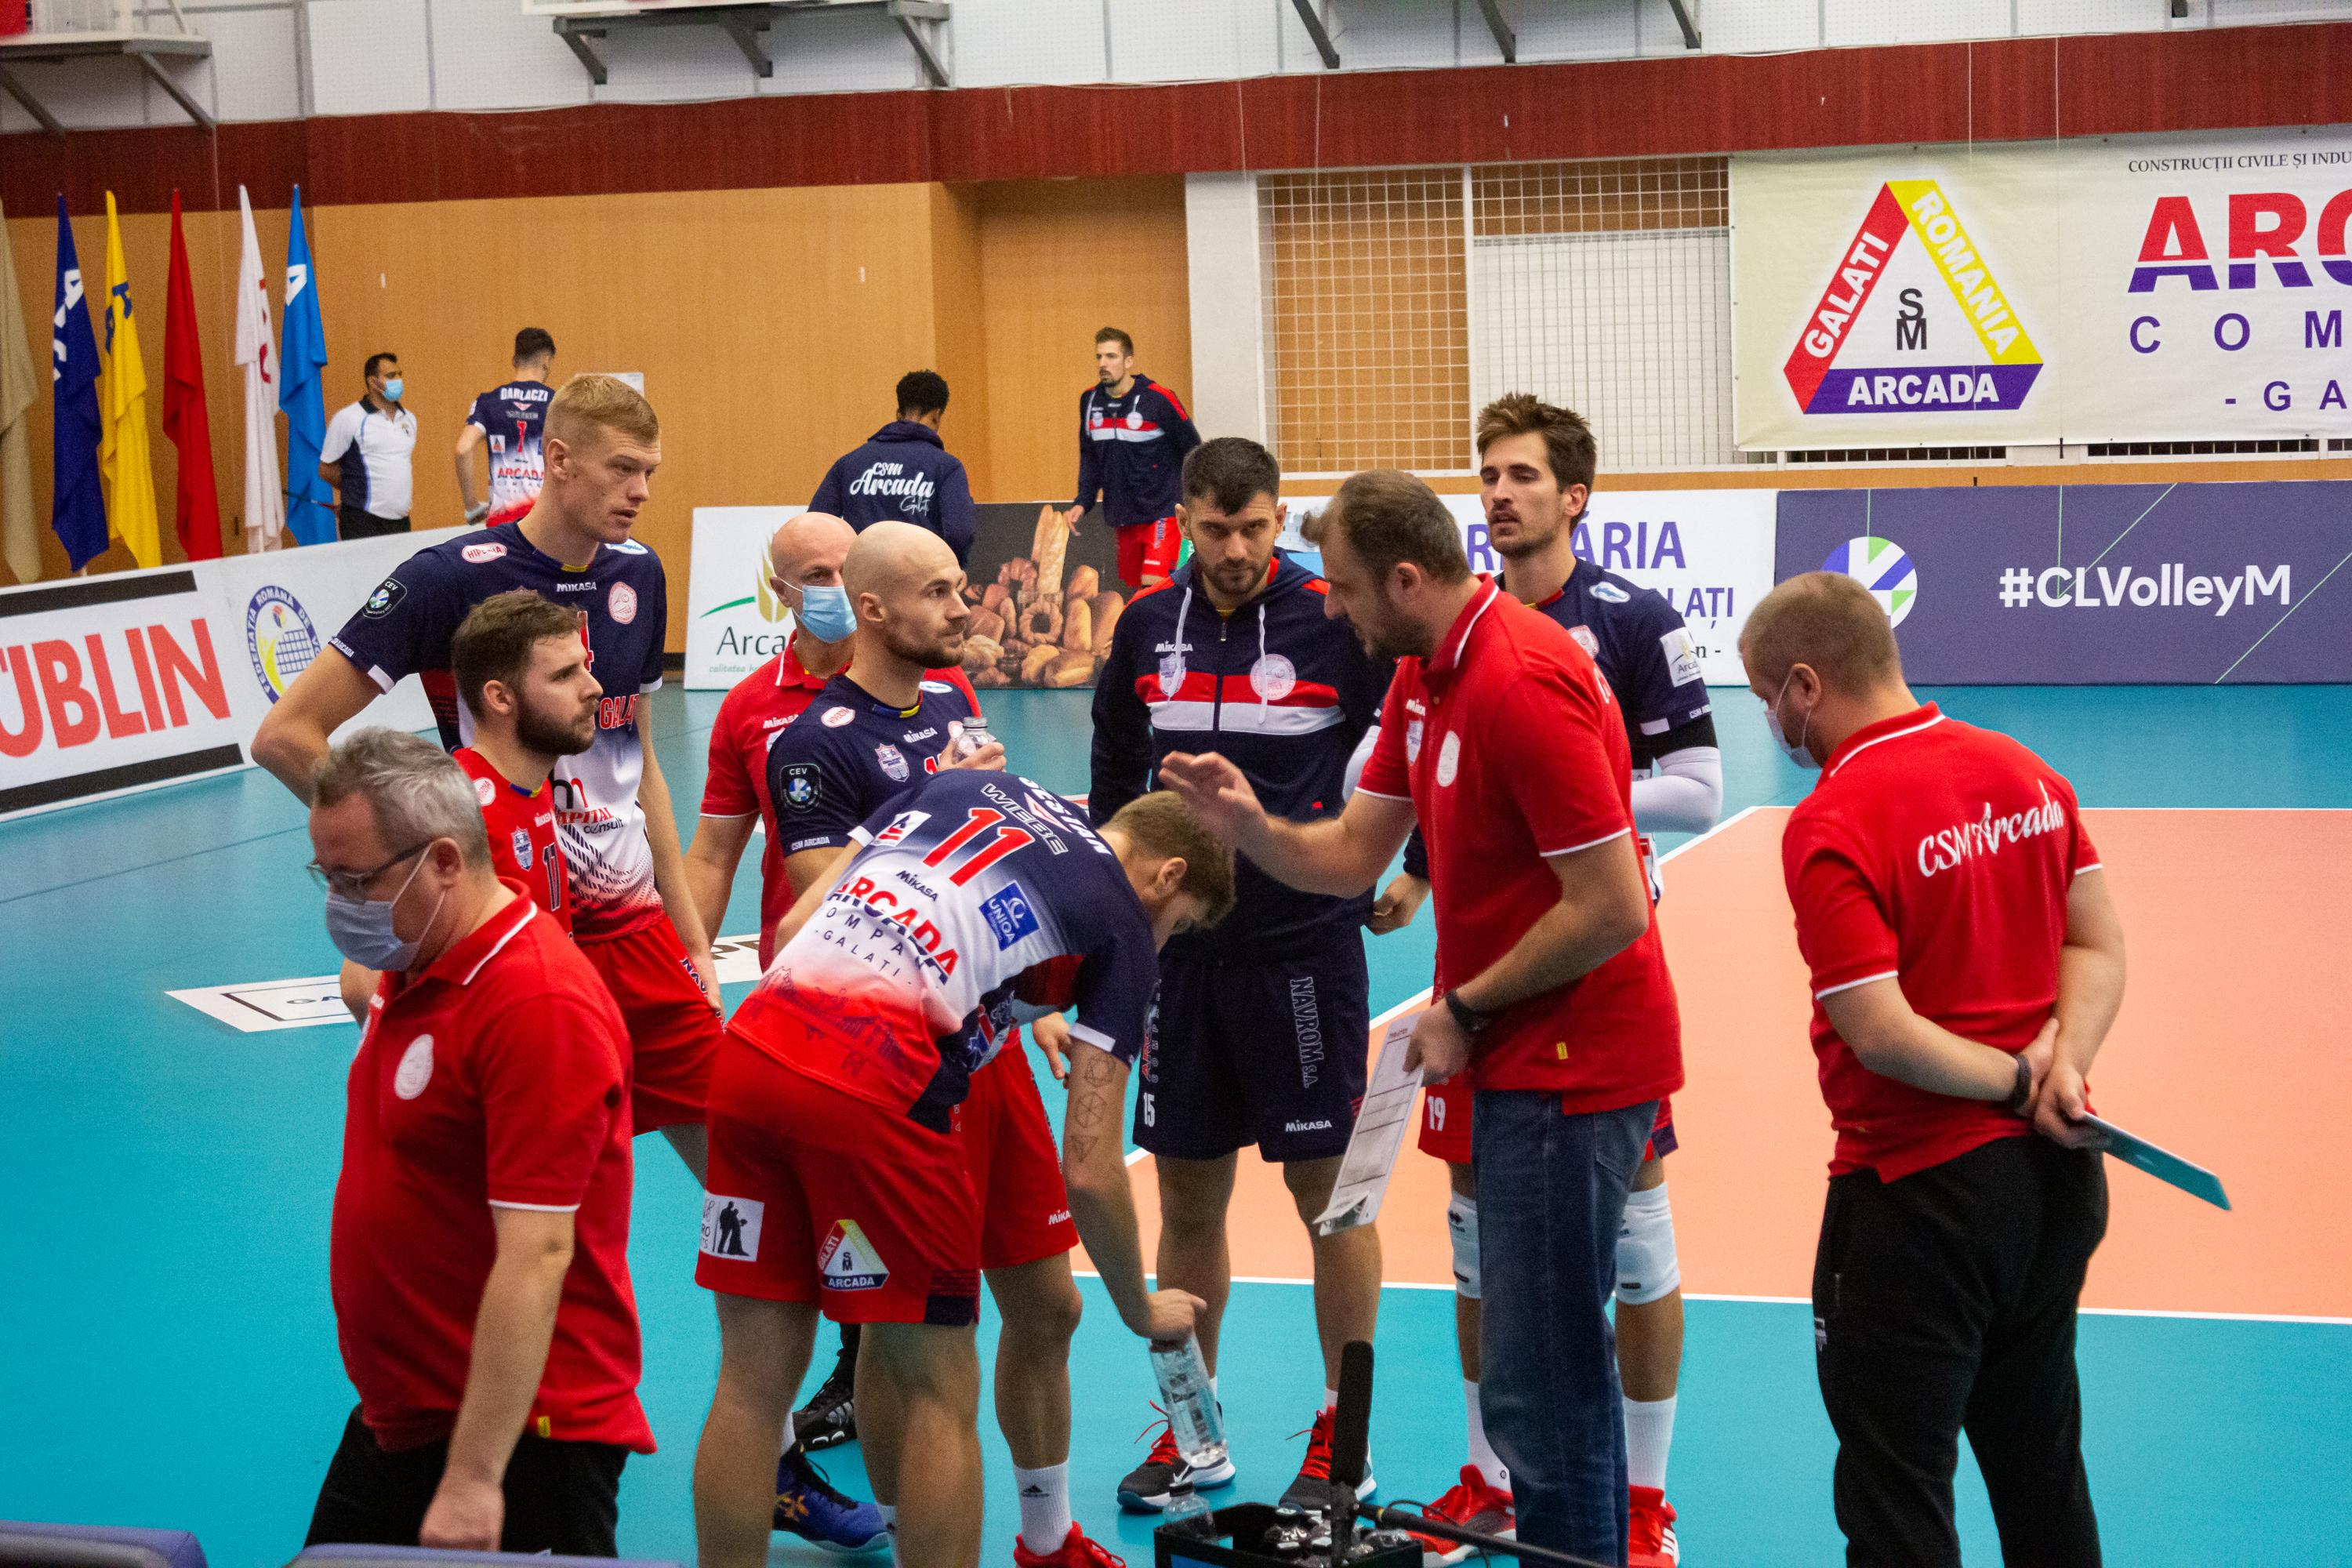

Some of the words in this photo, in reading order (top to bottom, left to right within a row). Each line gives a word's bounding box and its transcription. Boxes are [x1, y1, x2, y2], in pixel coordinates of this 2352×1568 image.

[2128, 156, 2233, 172] CONSTRUCȚII
[2238, 154, 2288, 169] CIVILE
[2293, 152, 2307, 169] ȘI
[1911, 191, 2019, 357] ROMANIA
[1804, 230, 1889, 359] GALATI
[1898, 287, 1925, 321] S
[1896, 318, 1928, 350] M
[1847, 372, 2000, 406] ARCADA
[516, 420, 528, 453] 7
[849, 468, 935, 498] Arcada
[1999, 563, 2291, 616] #CLVolleyM
[557, 807, 614, 826] APITAL
[981, 782, 1069, 855] WIEBE
[1918, 822, 1973, 877] CSM
[1972, 779, 2064, 855] Arcada
[804, 836, 830, 847] ARCADA
[922, 808, 1036, 887] 11
[827, 875, 959, 985] ARCADA
[988, 898, 1016, 944] UNIQA
[1290, 976, 1325, 1064] NAVROM
[1143, 1092, 1156, 1127] 15
[1427, 1095, 1446, 1131] 19
[828, 1276, 875, 1287] ARCADA
